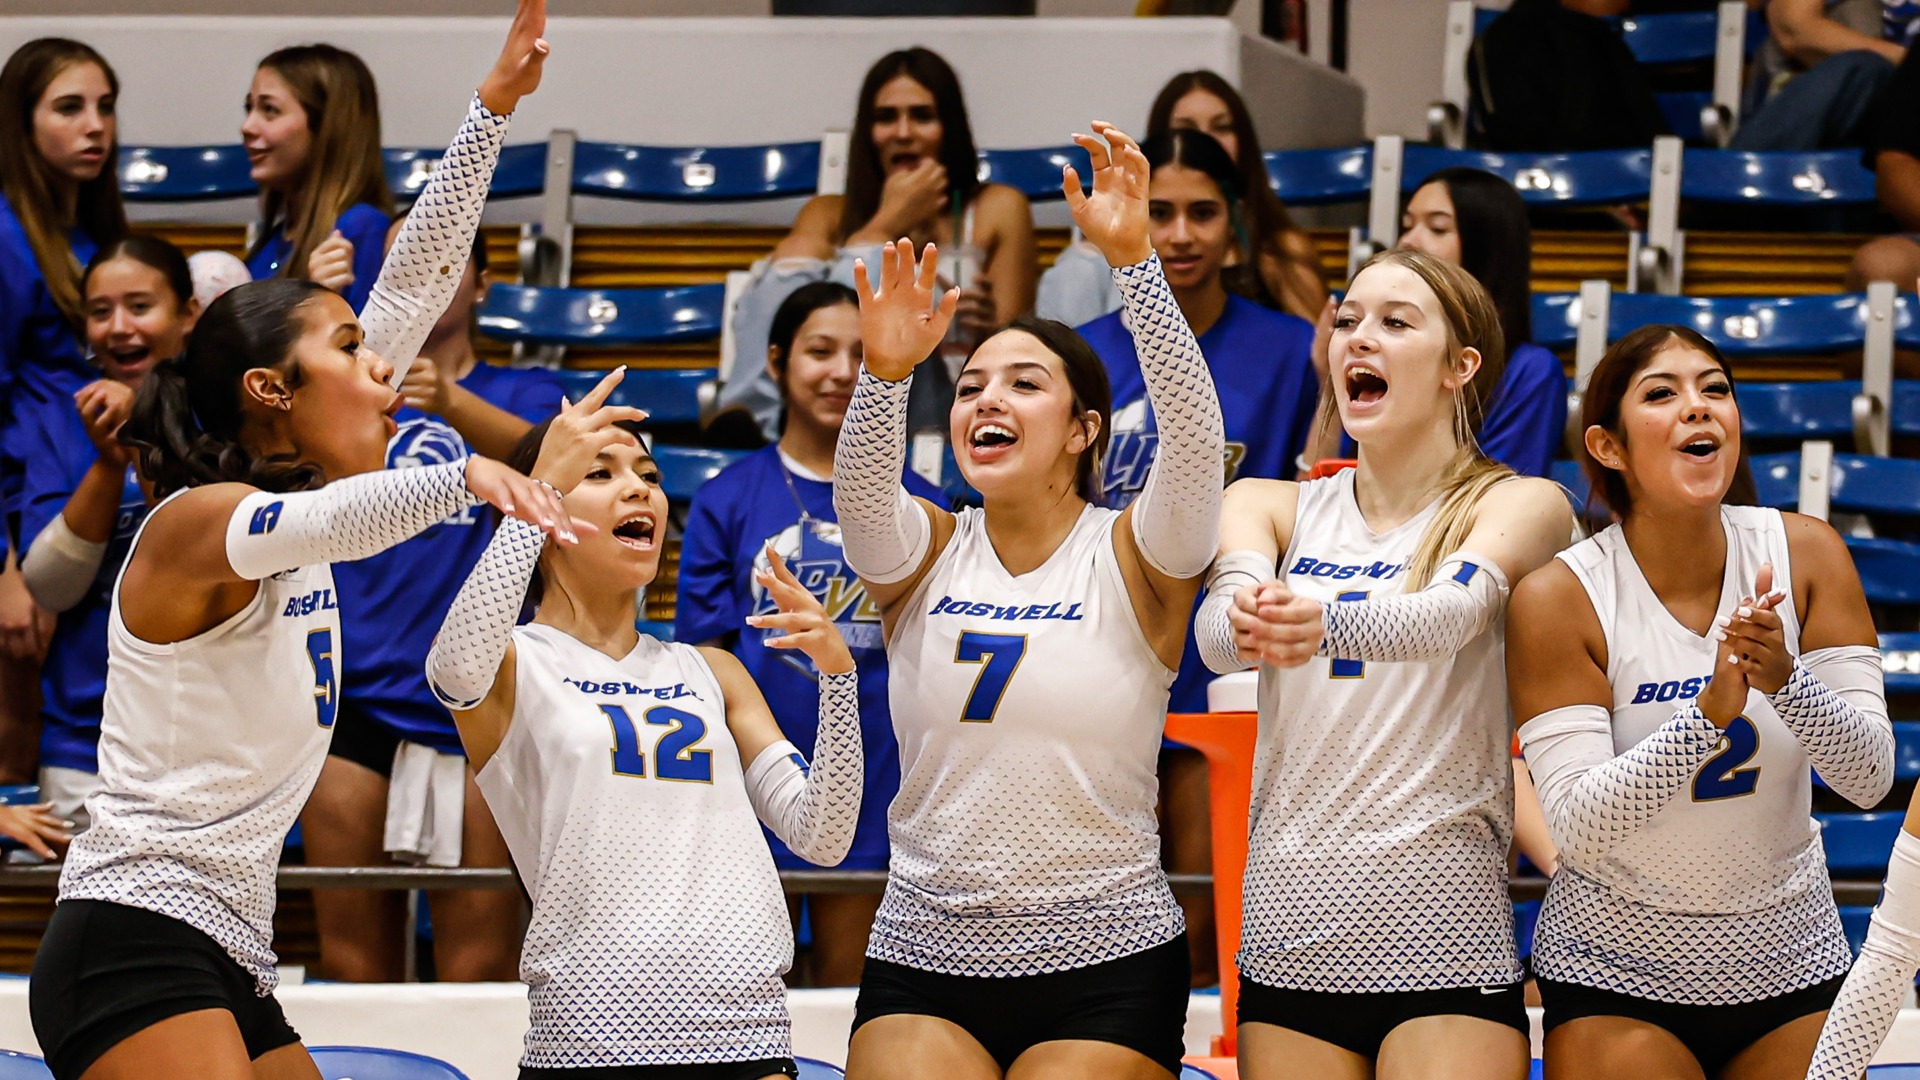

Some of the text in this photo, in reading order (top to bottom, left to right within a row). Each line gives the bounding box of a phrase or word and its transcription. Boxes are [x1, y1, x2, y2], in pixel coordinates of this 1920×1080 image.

[928, 595, 1084, 621] BOSWELL
[1452, 560, 1479, 586] 1
[306, 626, 337, 729] 5
[953, 629, 1029, 723] 7
[1630, 674, 1713, 705] BOS
[596, 703, 714, 785] 12
[1691, 713, 1761, 803] 2
